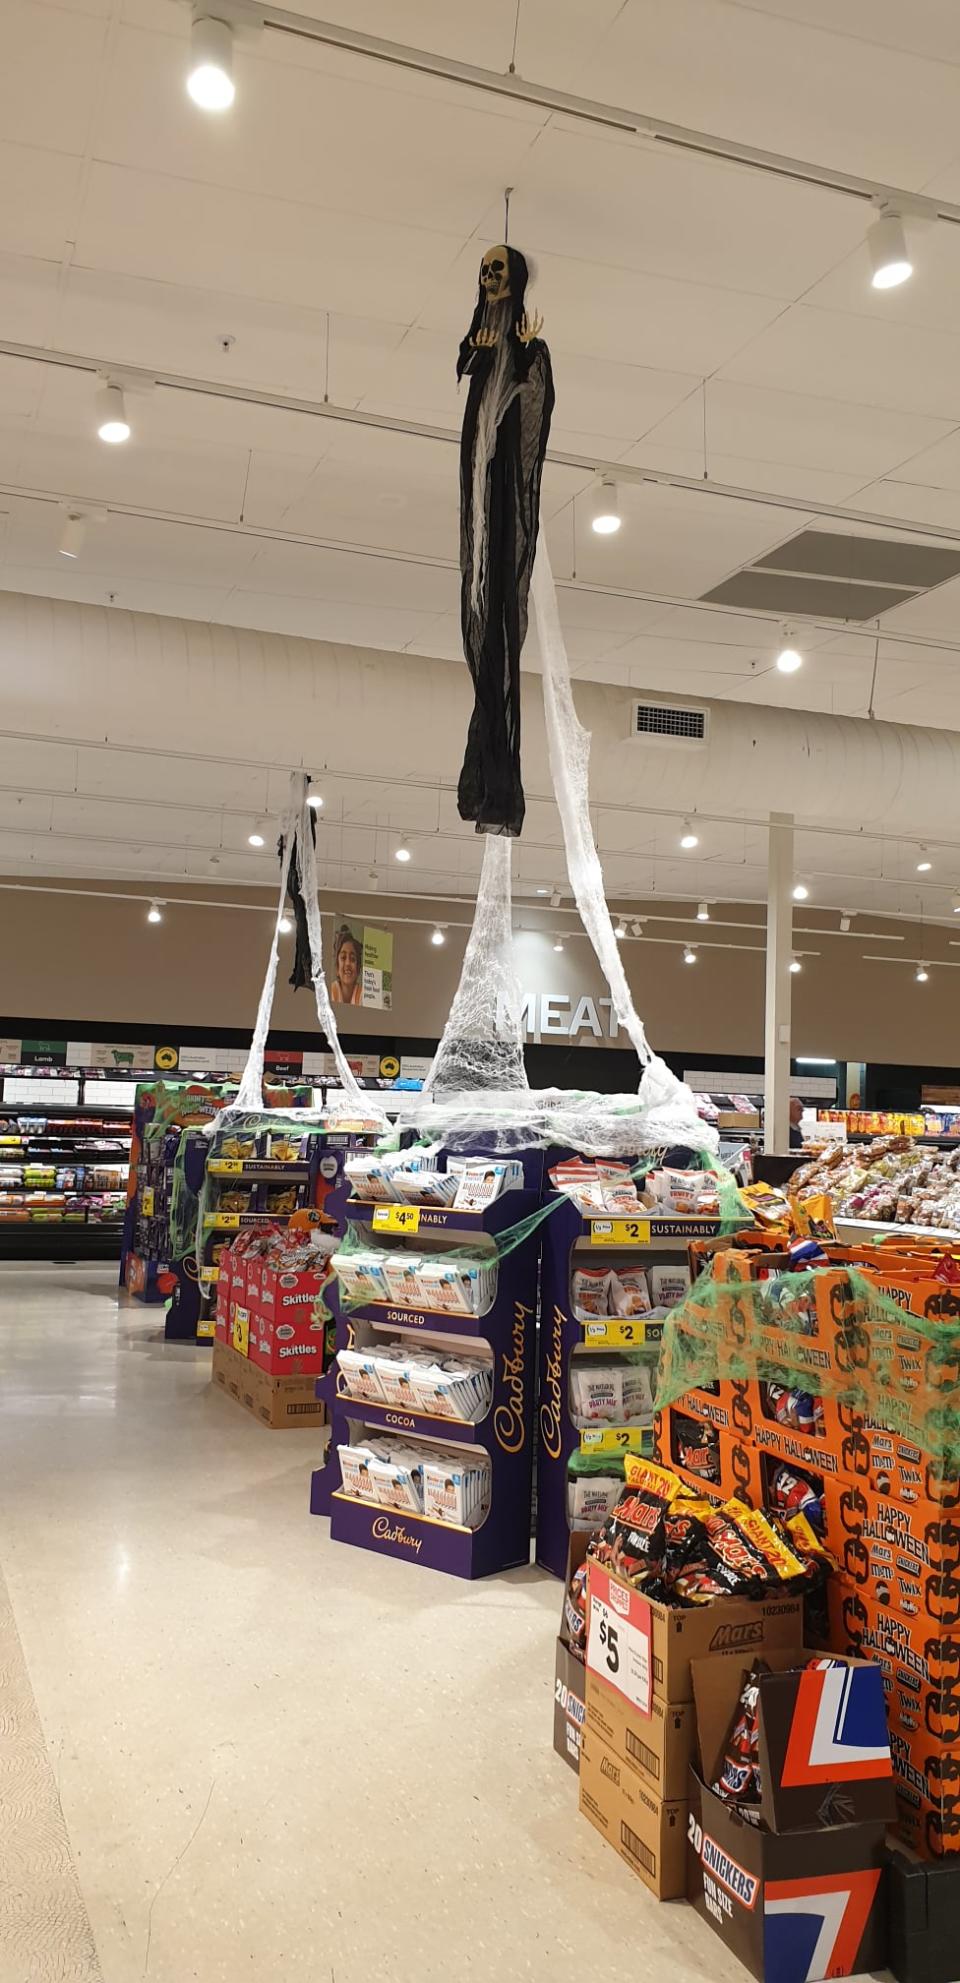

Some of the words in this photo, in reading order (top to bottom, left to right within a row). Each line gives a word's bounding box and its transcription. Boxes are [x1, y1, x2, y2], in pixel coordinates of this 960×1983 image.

[496, 992, 619, 1038] MEAT
[625, 1223, 639, 1238] $2
[651, 1224, 716, 1235] SUSTAINABLY
[386, 1310, 425, 1325] SOURCED
[619, 1325, 634, 1340] $2
[279, 1344, 317, 1358] Skittles
[494, 1301, 533, 1452] Cadbury
[540, 1305, 568, 1459] Cadbury
[385, 1413, 416, 1428] COCOA
[687, 1398, 730, 1427] HALLOWEEN
[616, 1432, 630, 1446] $2
[755, 1425, 782, 1451] HAPPY
[784, 1436, 838, 1473] HALLOWEEN
[872, 1435, 893, 1449] Mars
[613, 1495, 661, 1532] Mars
[877, 1503, 912, 1533] HAPPY
[372, 1516, 422, 1553] Cadbury
[748, 1519, 775, 1553] GIANT
[862, 1519, 930, 1567] HALLOWEEN
[872, 1544, 892, 1559] Mars
[711, 1622, 764, 1649] Mars
[877, 1613, 912, 1646] HAPPY
[599, 1619, 620, 1673] $5
[862, 1627, 930, 1682] HALLOWEEN
[555, 1678, 568, 1709] 20
[889, 1731, 911, 1762] PPY
[688, 1812, 702, 1855] 20
[703, 1840, 755, 1904] SNICKERS
[702, 1872, 718, 1897] FUN
[716, 1886, 734, 1919] SIZE
